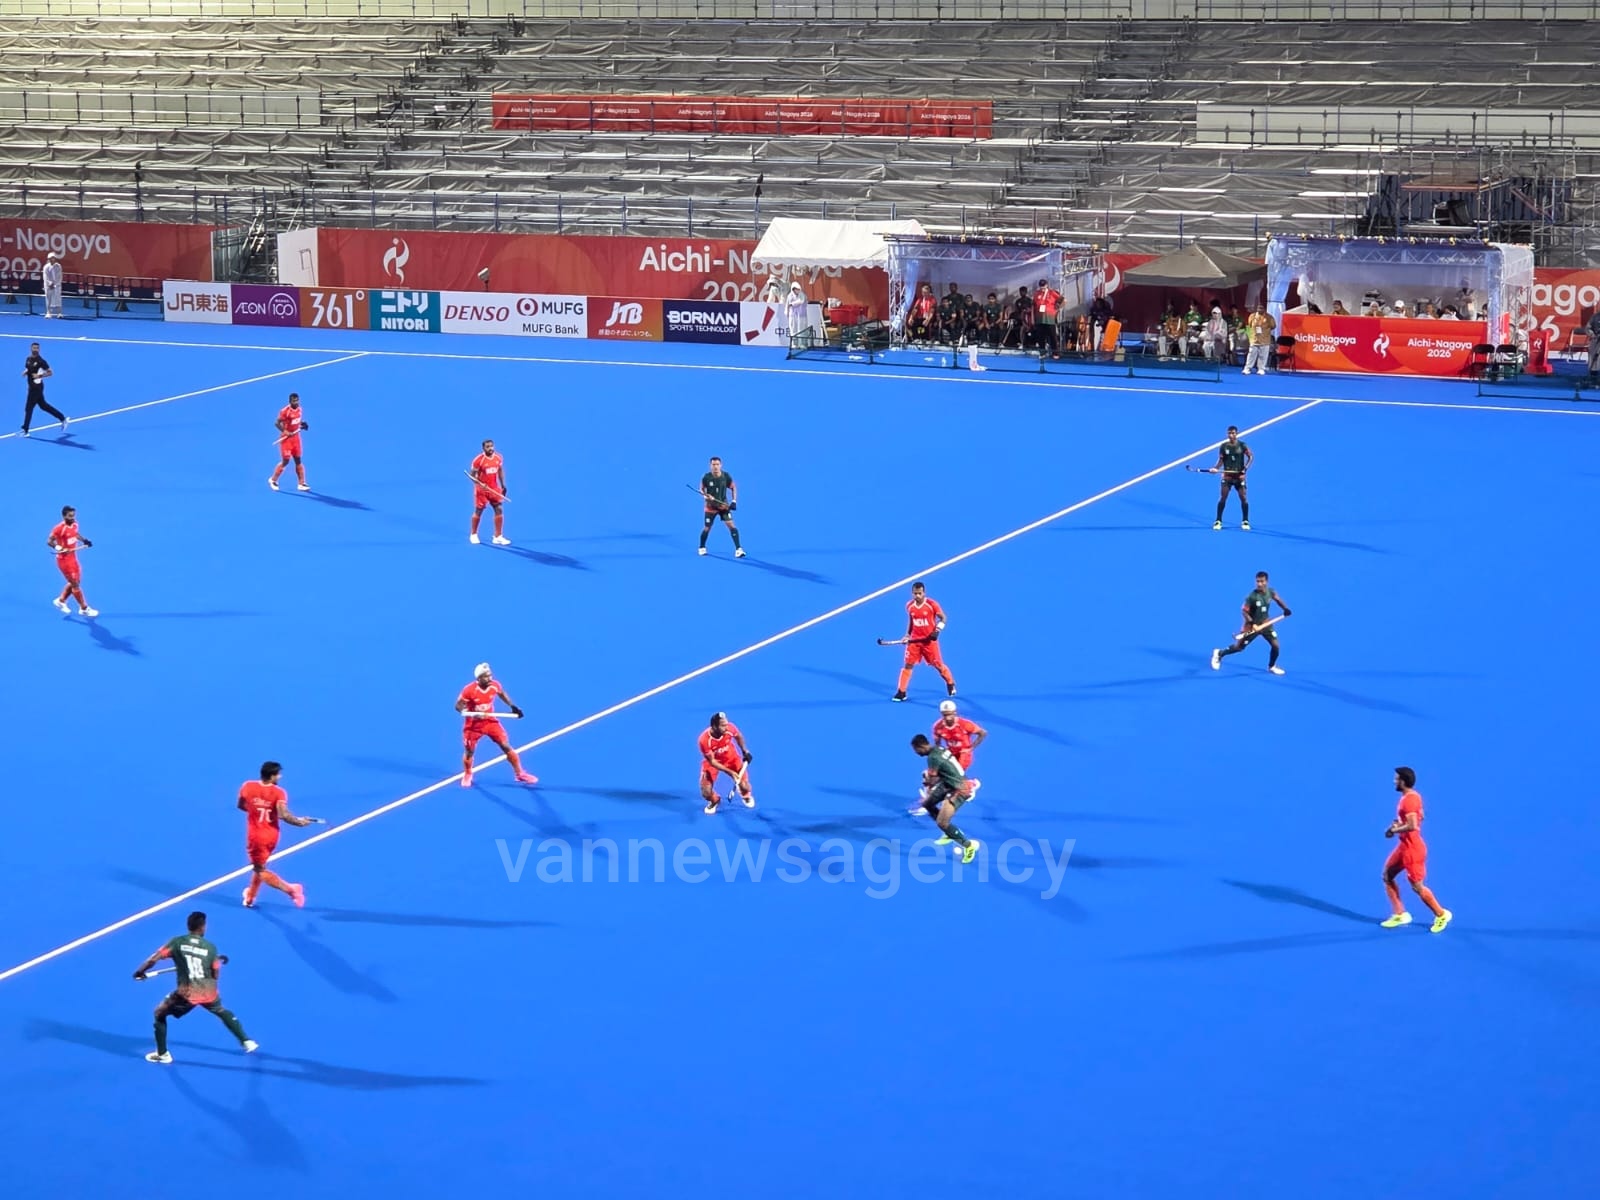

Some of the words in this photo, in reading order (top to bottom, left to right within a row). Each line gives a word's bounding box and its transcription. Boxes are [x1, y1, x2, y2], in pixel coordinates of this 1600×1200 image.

[764, 110, 800, 118] AichiNagoya
[831, 110, 867, 118] Aic-Nagoya
[0, 227, 111, 260] -Nagoya
[0, 256, 43, 280] 202
[166, 292, 229, 313] JR東海
[380, 291, 428, 314] ニトリ
[541, 301, 584, 316] MUFG
[444, 304, 510, 322] DENSO
[605, 301, 643, 327] JTB
[666, 310, 738, 326] BORNAN
[380, 316, 429, 332] NITORI
[522, 322, 553, 334] MUFG
[554, 323, 580, 336] Bank
[669, 323, 694, 332] SPORTS
[695, 324, 738, 334] TECHNOLOGY
[1294, 333, 1357, 346] Aichi-Nagoya
[1407, 337, 1473, 350] Aichi-Nagoya
[1312, 344, 1336, 353] 2026
[1427, 349, 1452, 358] 2026
